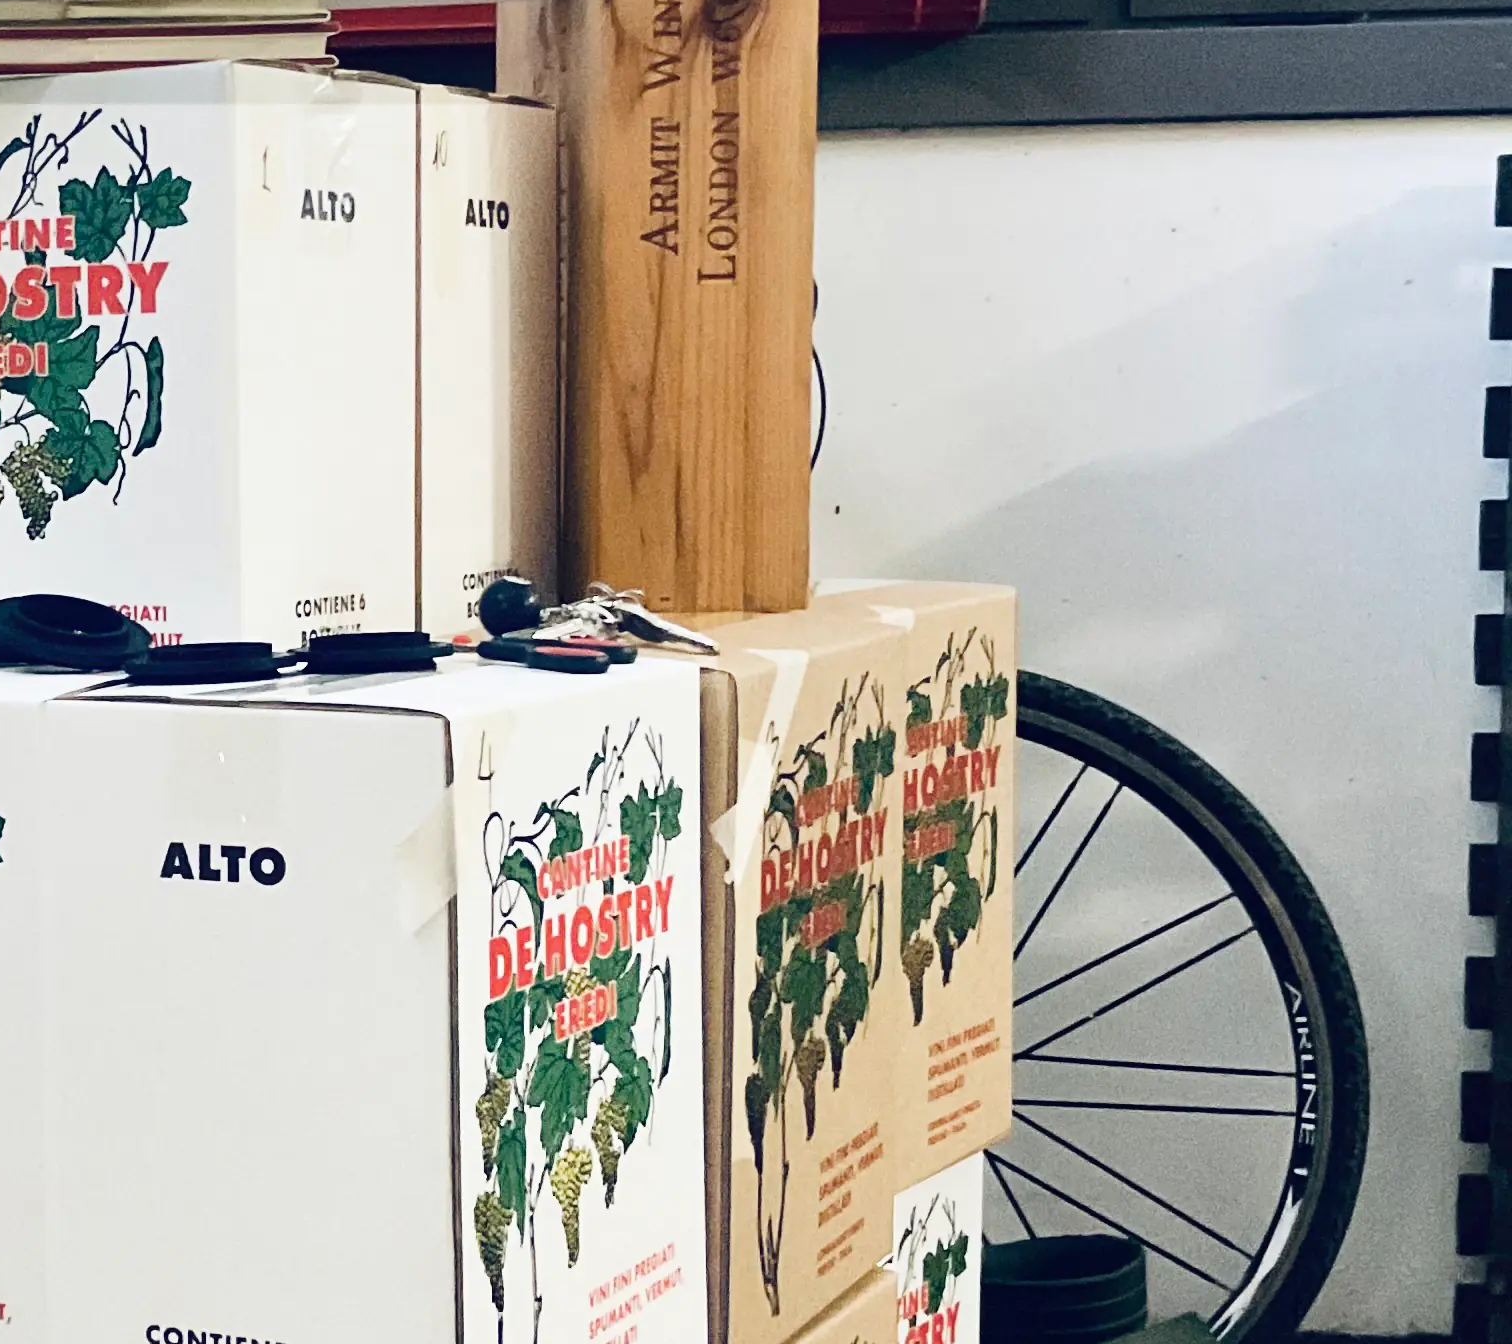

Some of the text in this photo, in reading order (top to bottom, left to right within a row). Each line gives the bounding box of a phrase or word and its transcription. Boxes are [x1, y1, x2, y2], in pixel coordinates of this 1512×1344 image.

[300, 188, 356, 223] ALTO
[464, 198, 510, 230] ALTO
[640, 116, 682, 257] ARMIT
[696, 109, 740, 286] LONDON
[295, 593, 368, 618] CONTIENE 6
[903, 744, 1001, 816] HOSTRY
[159, 841, 287, 886] ALTO
[537, 835, 631, 902] CANTINE
[760, 807, 888, 913] DE HOSTRY
[488, 875, 676, 1002] DE HOSTRY
[554, 980, 619, 1044] EREDI
[589, 1281, 611, 1308] VINI
